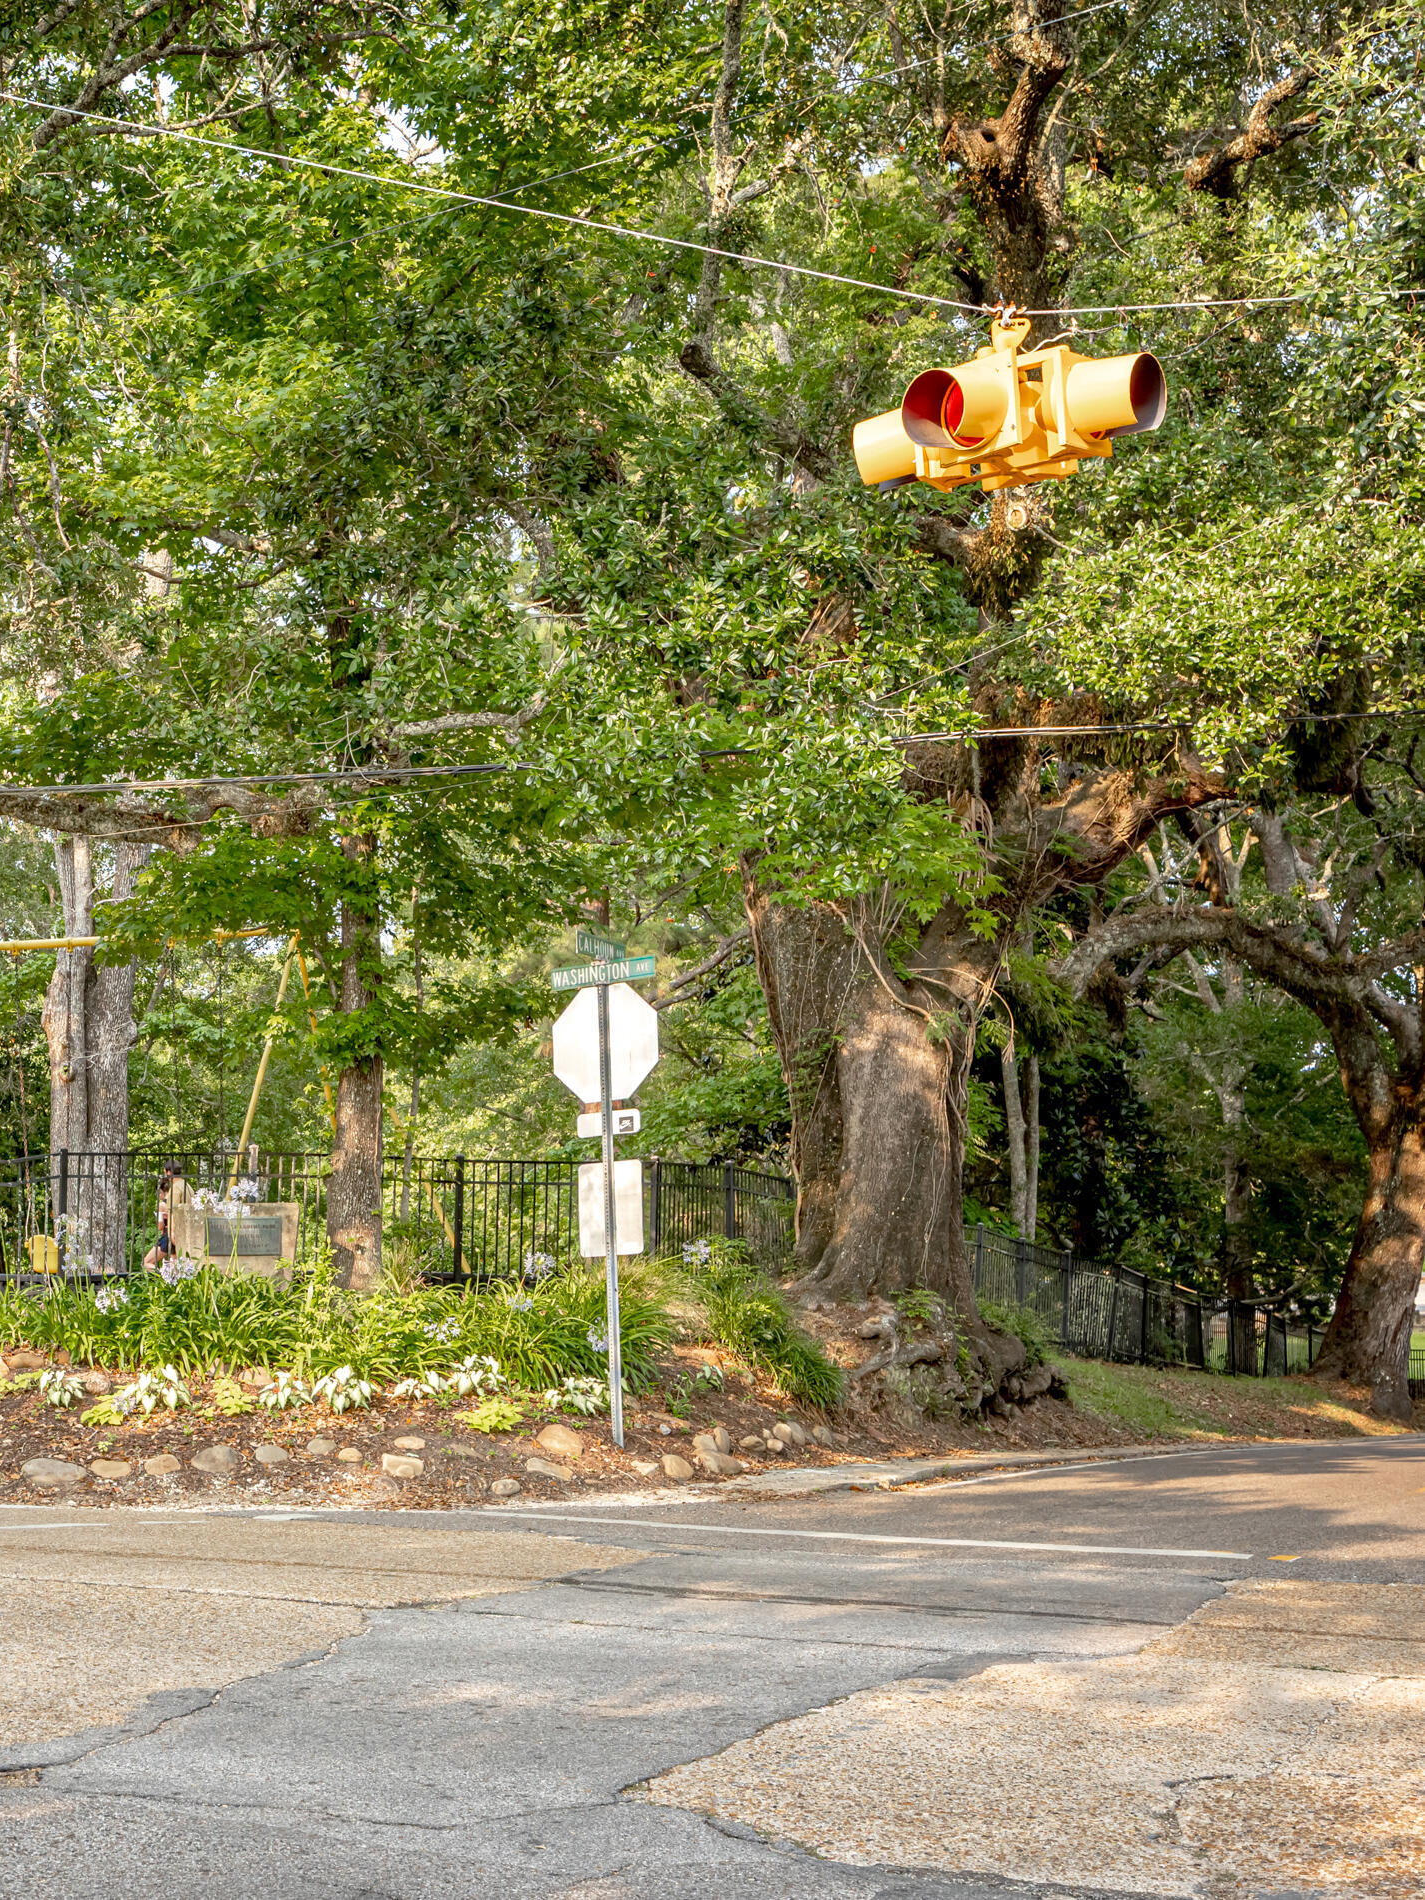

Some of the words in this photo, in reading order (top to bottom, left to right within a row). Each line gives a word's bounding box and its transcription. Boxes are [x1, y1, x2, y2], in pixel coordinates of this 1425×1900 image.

[578, 934, 614, 957] CALHOUN
[552, 961, 630, 988] WASHINGTON
[636, 961, 649, 972] AVE
